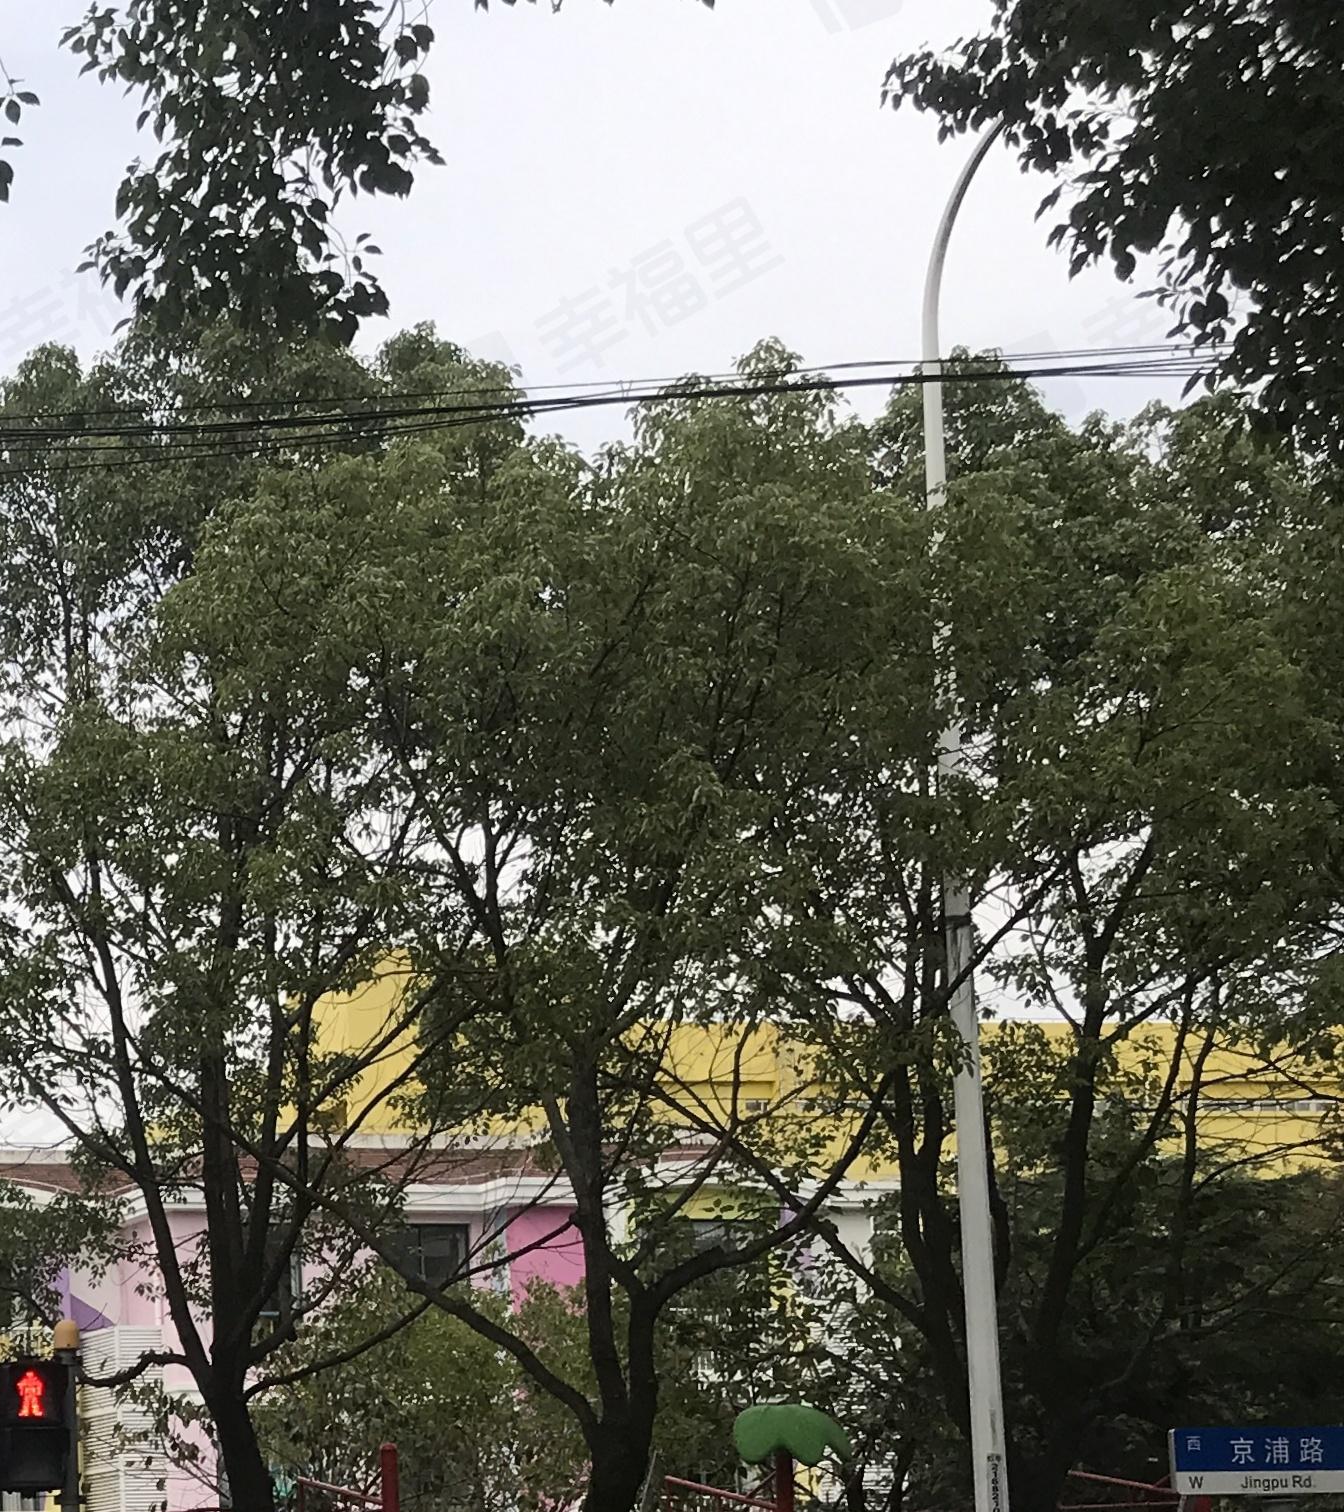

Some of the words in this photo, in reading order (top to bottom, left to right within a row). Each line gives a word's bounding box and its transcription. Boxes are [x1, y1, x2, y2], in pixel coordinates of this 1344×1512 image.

[1186, 1435, 1201, 1451] 西
[1229, 1436, 1324, 1464] 京浦路
[1188, 1475, 1204, 1489] W
[1240, 1475, 1289, 1491] Jingpu
